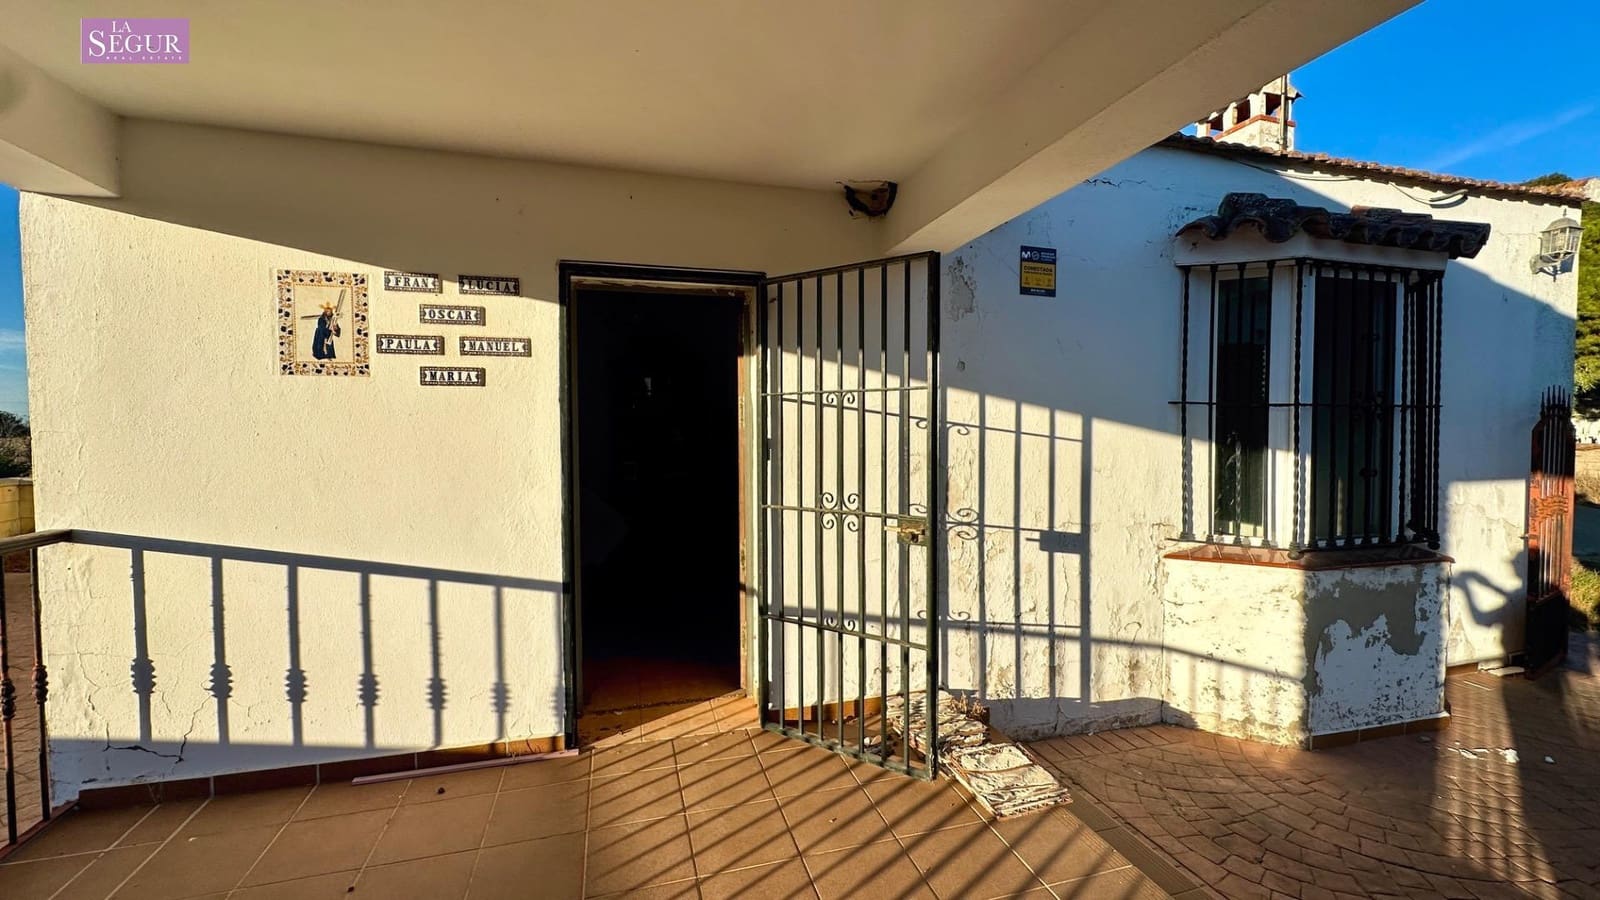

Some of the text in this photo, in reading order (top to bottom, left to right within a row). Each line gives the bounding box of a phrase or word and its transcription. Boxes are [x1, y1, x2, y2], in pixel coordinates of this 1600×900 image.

[394, 276, 429, 288] FRAN
[468, 279, 510, 291] LUCIA
[428, 309, 473, 320] OSCAR
[386, 338, 431, 350] PAULA
[469, 340, 519, 352] MANUEL
[429, 371, 473, 382] MARIA
